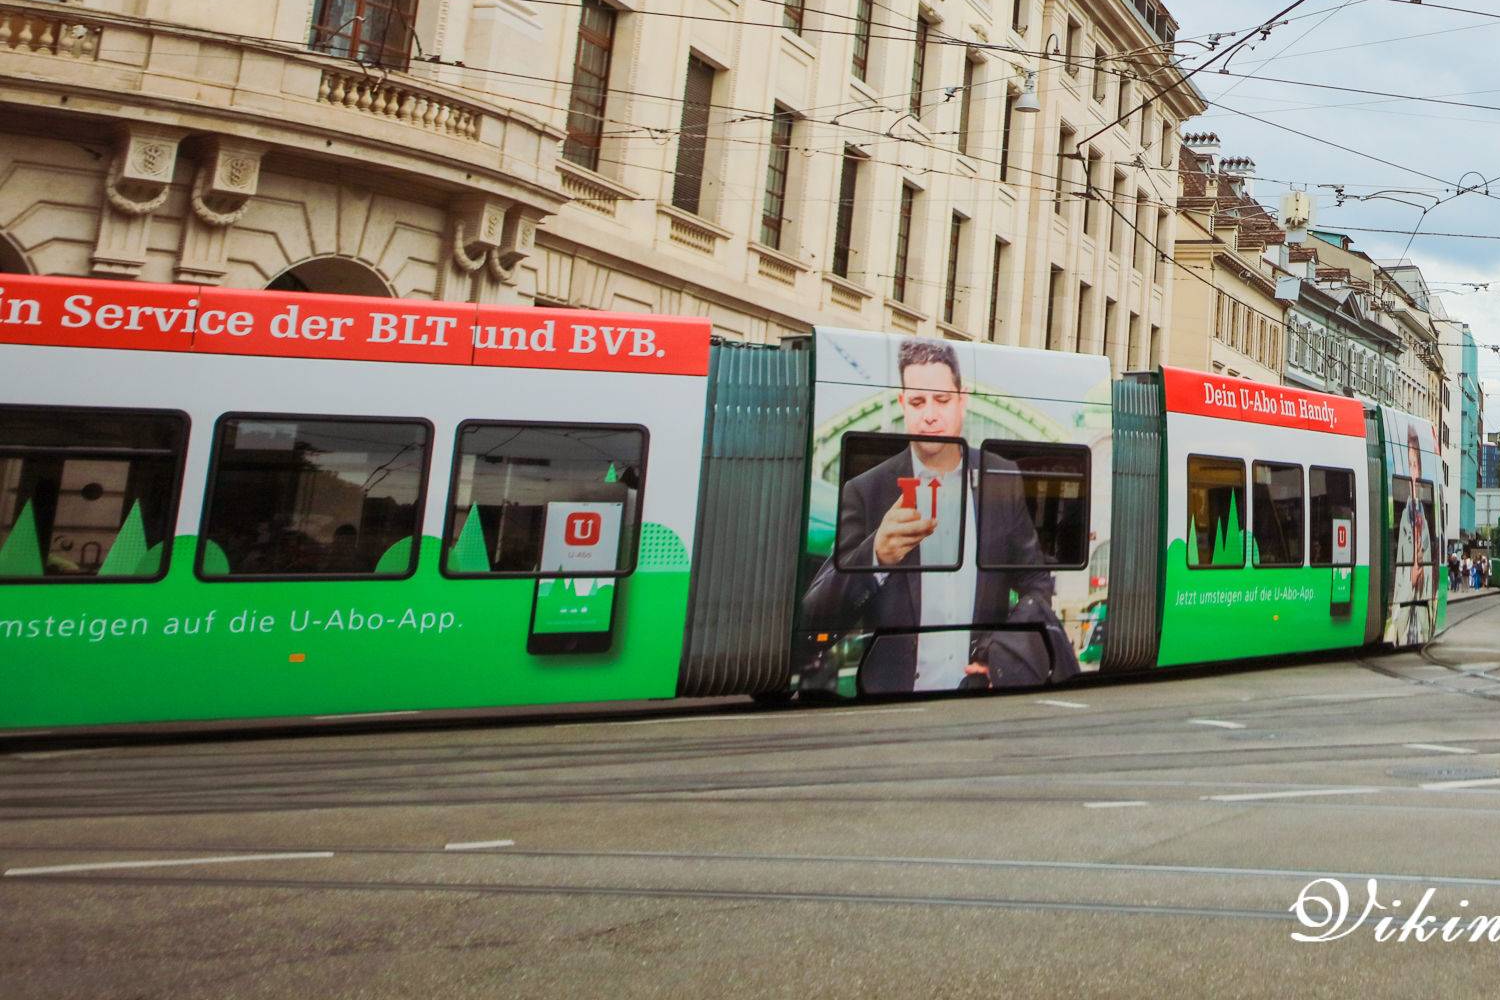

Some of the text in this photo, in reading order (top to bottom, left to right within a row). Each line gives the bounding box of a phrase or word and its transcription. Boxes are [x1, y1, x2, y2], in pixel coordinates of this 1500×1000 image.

[60, 294, 255, 337] Service
[269, 305, 354, 342] der
[366, 311, 457, 346] BLT
[469, 320, 557, 353] und
[568, 323, 666, 358] BVB.
[1203, 382, 1338, 428] Dein U-Abo im Handy.
[572, 519, 594, 539] U
[1176, 586, 1316, 607] Jetzt umsteigen auf die U-Abo-App.
[163, 610, 217, 635] auf
[229, 609, 275, 634] die
[289, 607, 464, 634] U-Abo-App.
